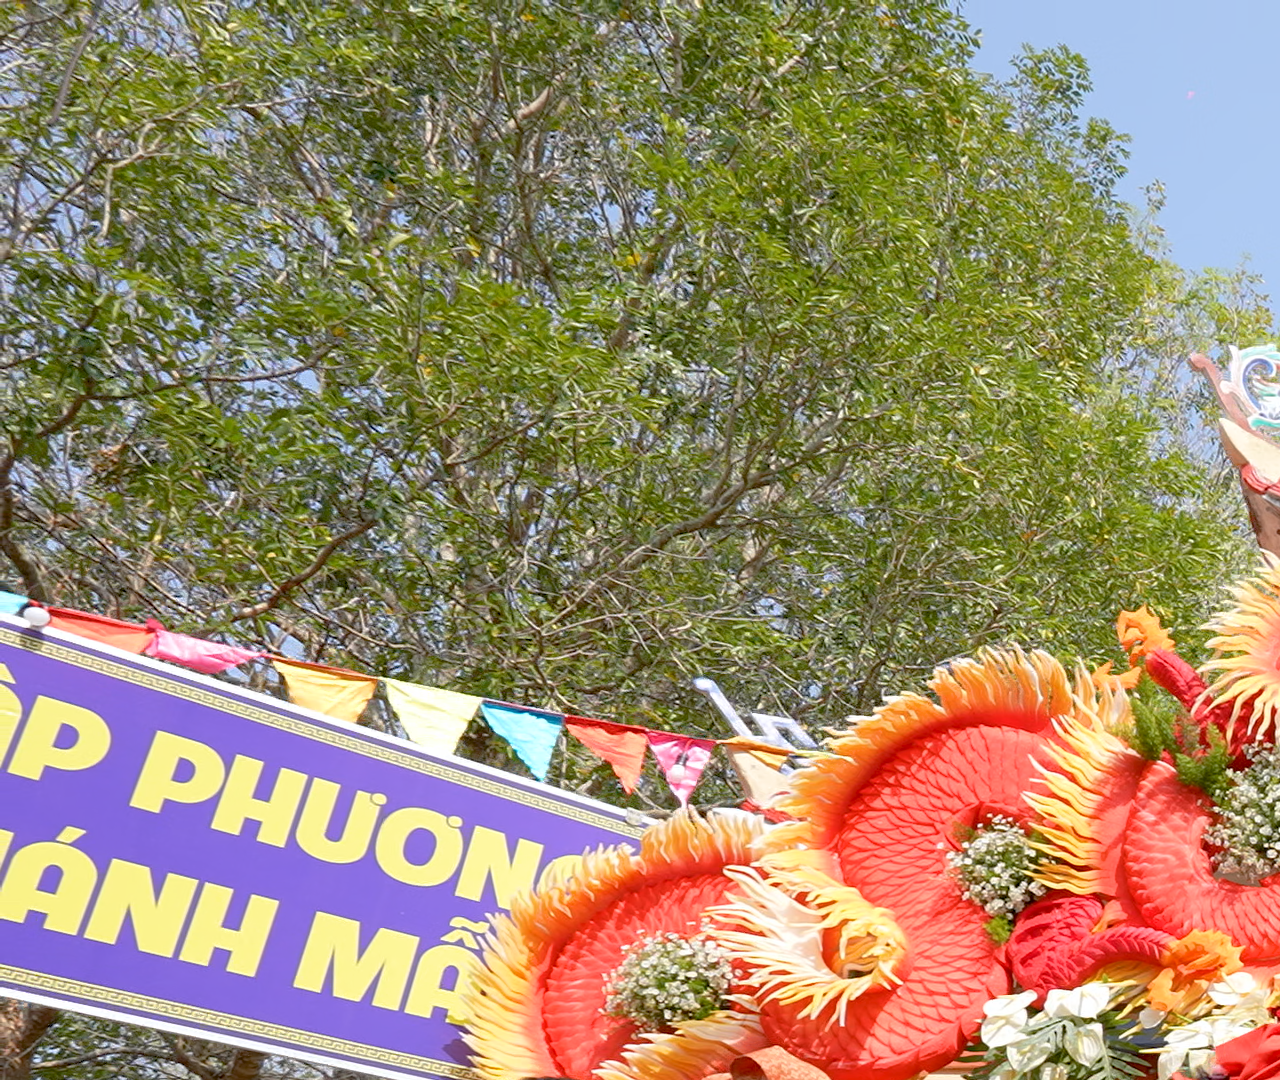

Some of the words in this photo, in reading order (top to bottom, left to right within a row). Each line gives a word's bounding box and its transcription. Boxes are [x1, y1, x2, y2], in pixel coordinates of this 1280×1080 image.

[0, 662, 111, 781] P
[0, 826, 279, 978] ÁNH
[293, 911, 490, 1024] MẪ
